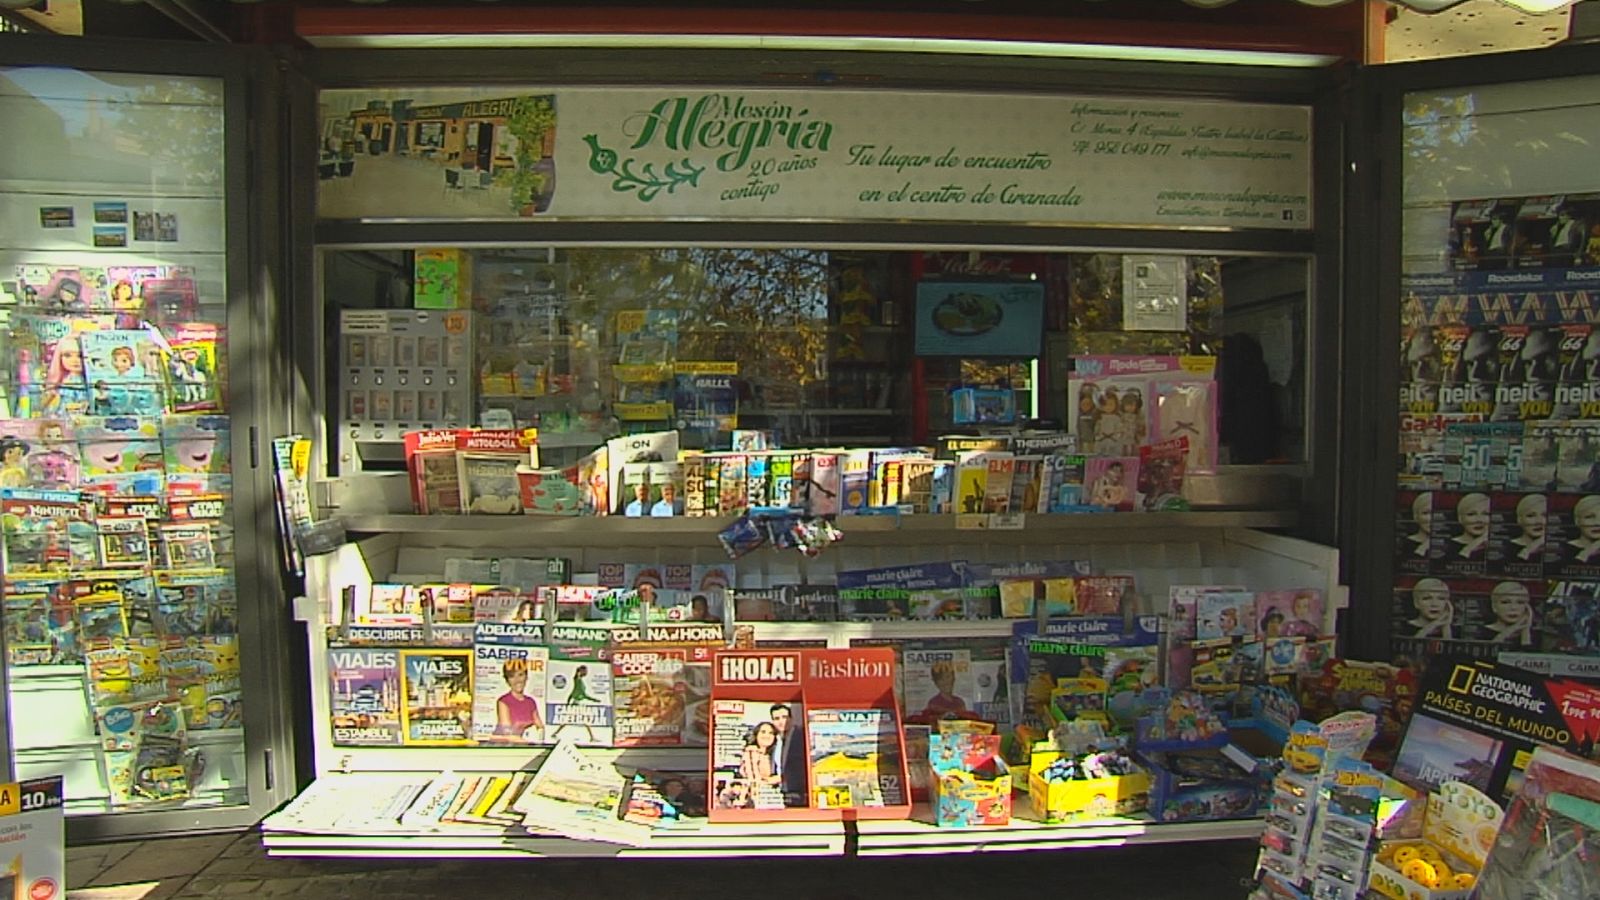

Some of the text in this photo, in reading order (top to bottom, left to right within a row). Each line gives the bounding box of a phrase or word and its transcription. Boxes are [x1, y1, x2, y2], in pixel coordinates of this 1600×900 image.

[717, 96, 792, 119] Mesón
[622, 93, 832, 172] Alegría
[747, 155, 817, 178] 20 años
[846, 145, 1051, 173] Tu lugar de encuentro
[720, 179, 780, 202] contigo
[858, 182, 1083, 206] en el centro de Granada
[866, 567, 923, 582] marie claire
[992, 562, 1047, 576] marie claire
[839, 587, 910, 599] marie claire
[350, 629, 409, 641] DESCUBRE
[476, 624, 542, 637] ADELGAZA
[680, 627, 722, 640] HORN
[1046, 621, 1108, 634] marie claire
[477, 648, 528, 660] SABER
[1029, 641, 1105, 656] marie claire
[332, 652, 396, 668] VIAJES
[505, 660, 545, 672] VIVIR
[613, 653, 658, 665] SABER
[906, 653, 953, 664] SABER
[413, 661, 462, 674] VIAJES
[622, 663, 684, 675] COCINAR
[722, 657, 794, 681] ¡HOLA!
[818, 658, 890, 678] fashion
[1476, 672, 1533, 698] NATIONAL
[1472, 685, 1546, 714] GEOGRAPHIC
[1425, 690, 1472, 716] PAÍSES
[1474, 706, 1504, 726] DEL
[1508, 717, 1570, 744] MUNDO
